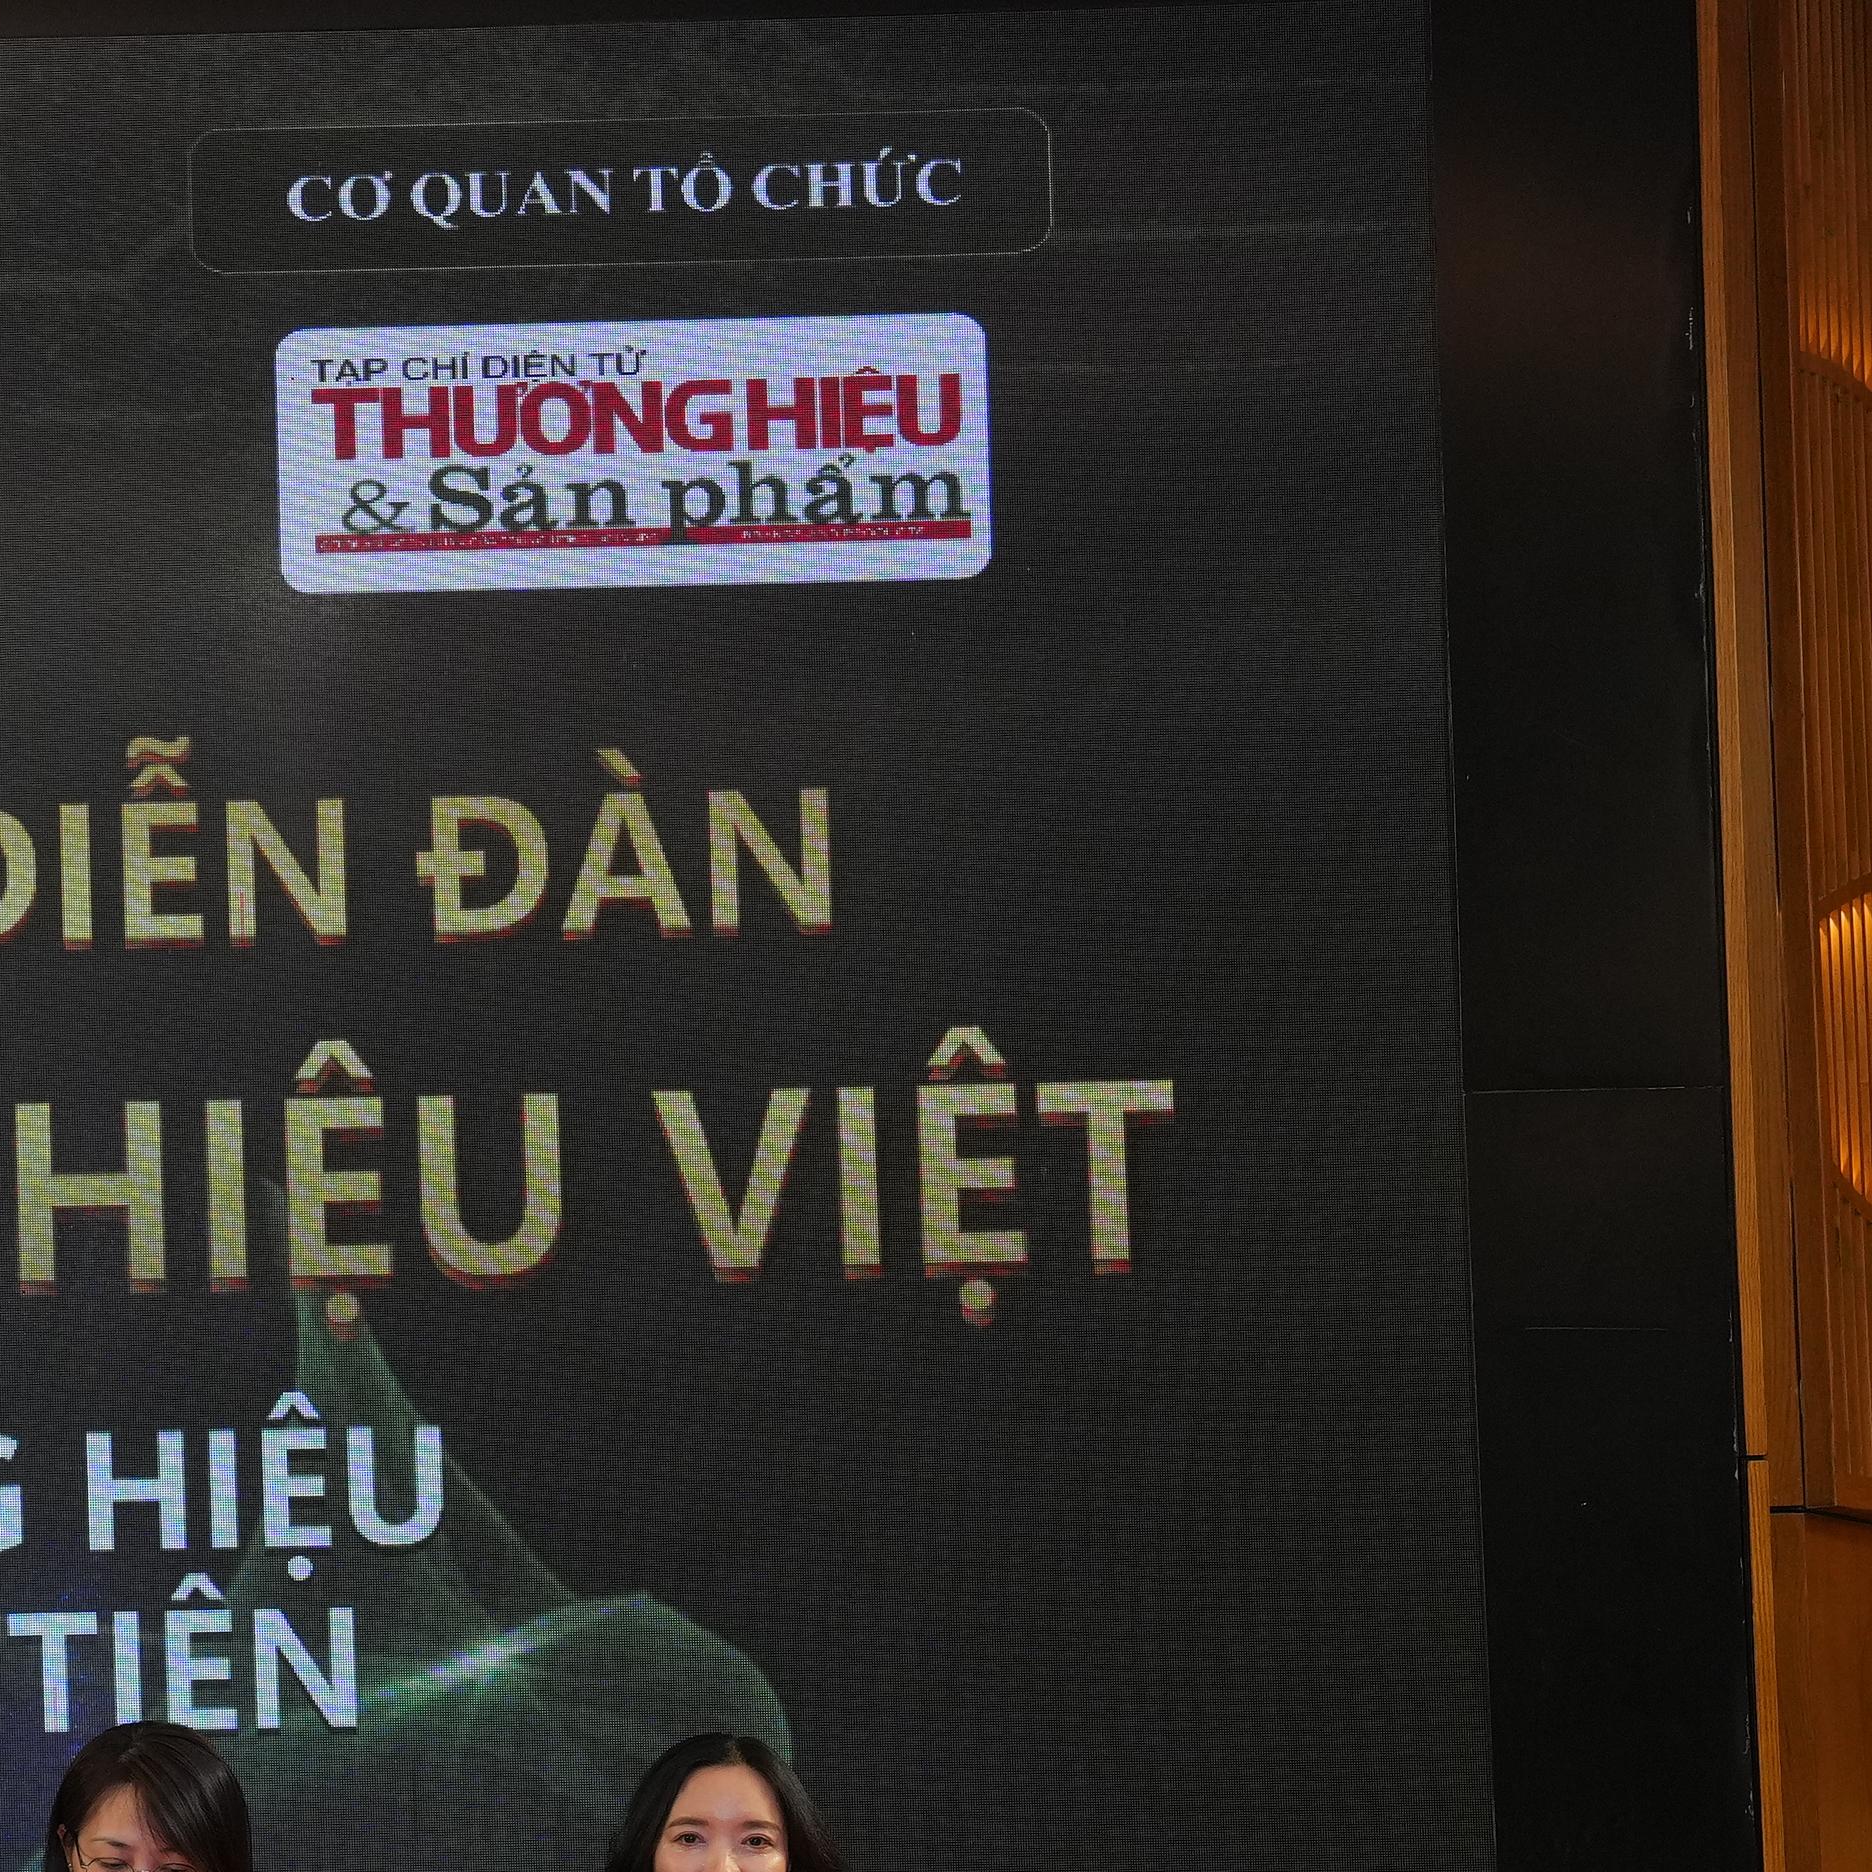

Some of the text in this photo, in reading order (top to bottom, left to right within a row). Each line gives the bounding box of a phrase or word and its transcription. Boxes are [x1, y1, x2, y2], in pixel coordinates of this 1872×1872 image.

[286, 147, 964, 228] CƠ QUAN TỔ CHỨC
[310, 357, 389, 386] TẠP
[402, 350, 469, 381] CHÍ
[588, 344, 647, 377] TỬ
[341, 452, 973, 544] & Sản phẩm
[416, 750, 831, 941] ĐÀN
[15, 1039, 561, 1324] HIỆU
[654, 1026, 1173, 1317] VIỆT
[87, 1390, 444, 1582] HIỆU
[7, 1570, 363, 1734] TIÊN
